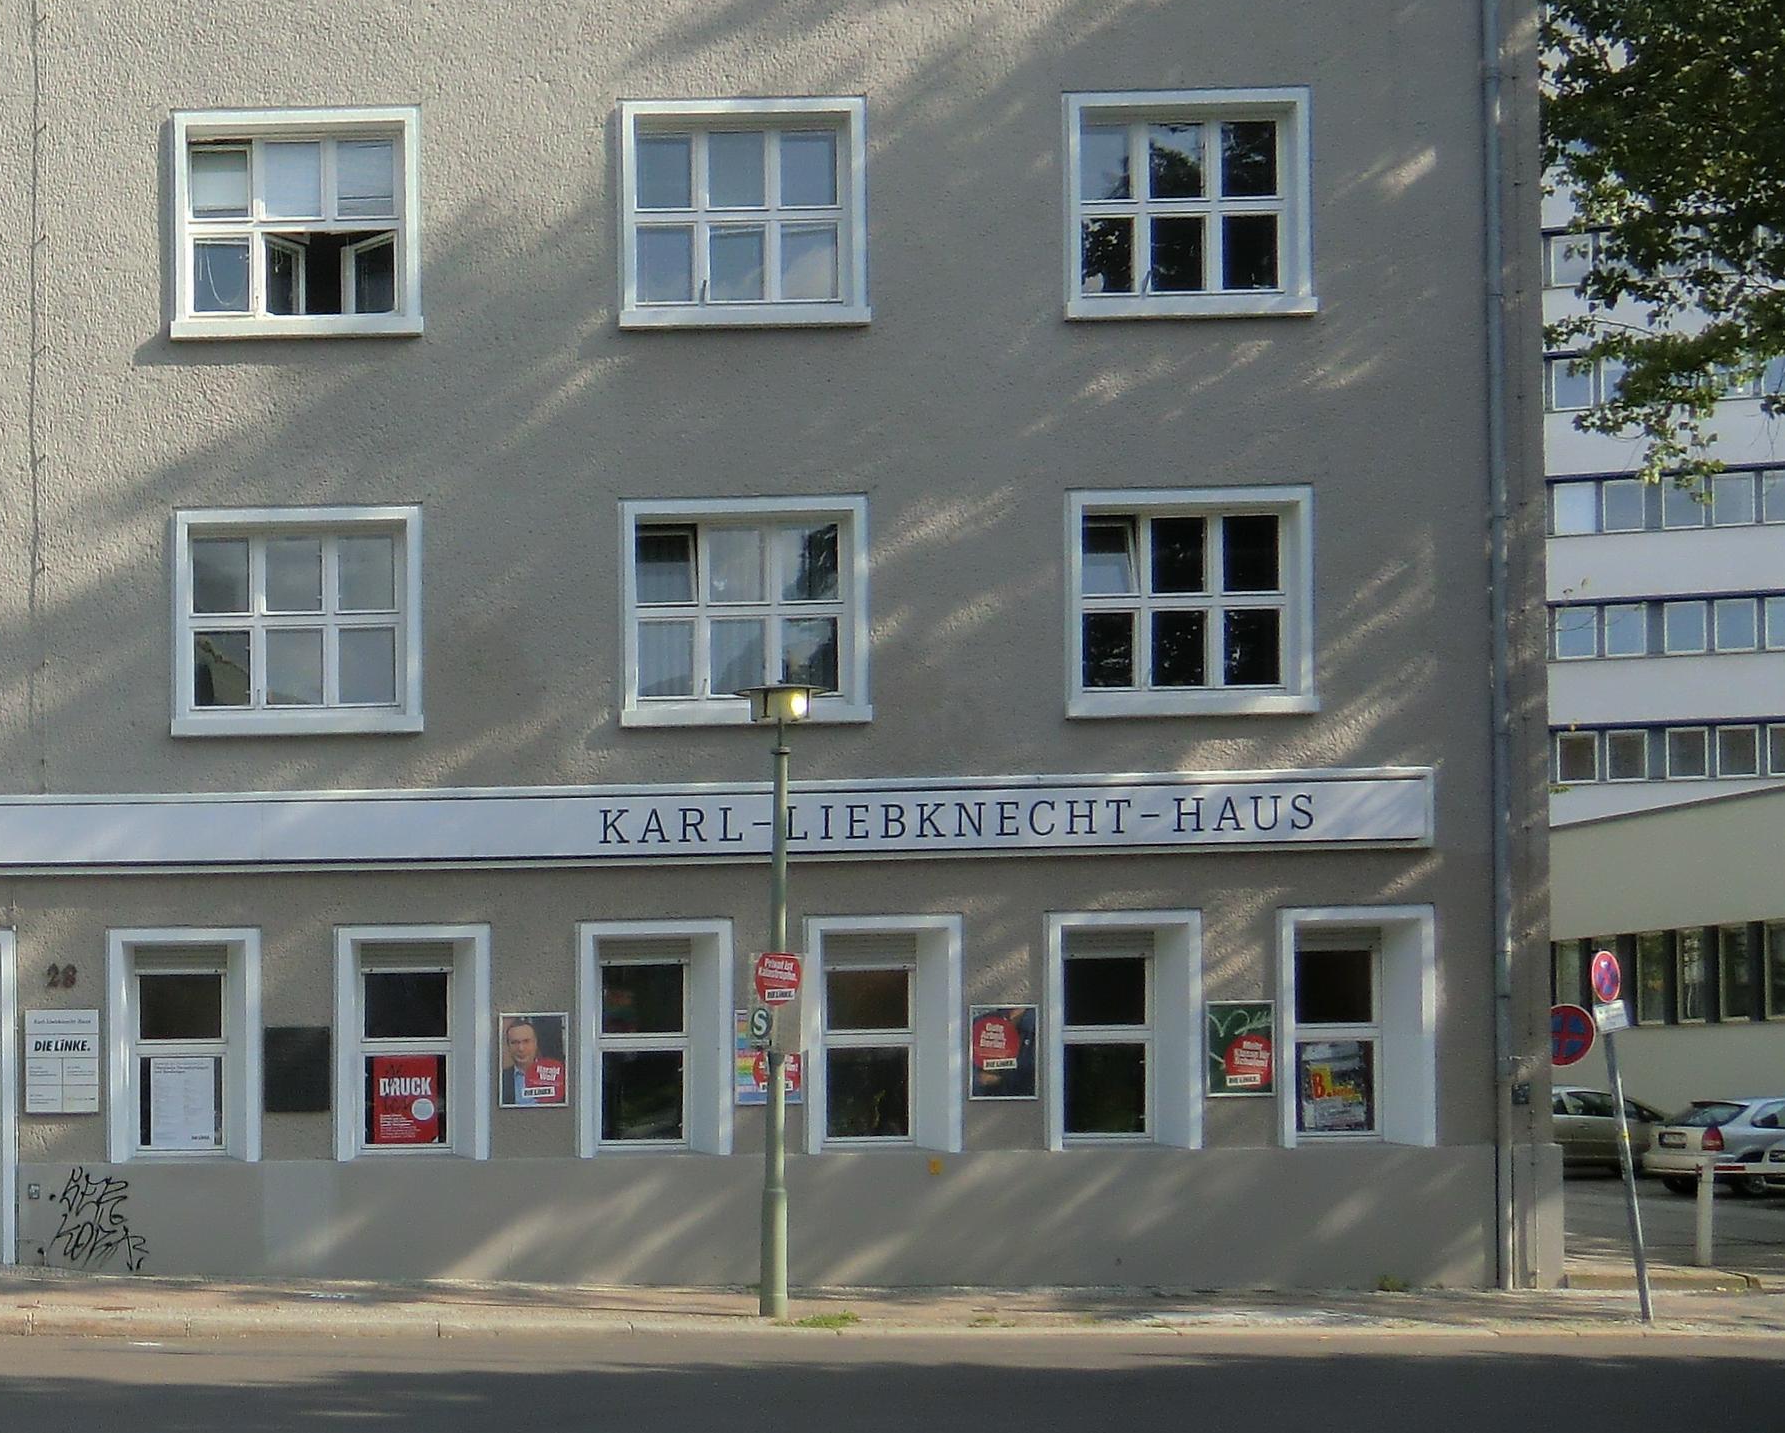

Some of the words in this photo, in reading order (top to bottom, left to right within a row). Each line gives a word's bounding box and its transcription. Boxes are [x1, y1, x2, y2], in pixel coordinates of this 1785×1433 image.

[599, 794, 1315, 845] KARL-LIEBKNECHT-HAUS
[46, 963, 77, 988] 28
[753, 1009, 768, 1036] S
[34, 1040, 53, 1052] DIE
[54, 1038, 91, 1052] LINKE.
[379, 1077, 432, 1096] DRUCK
